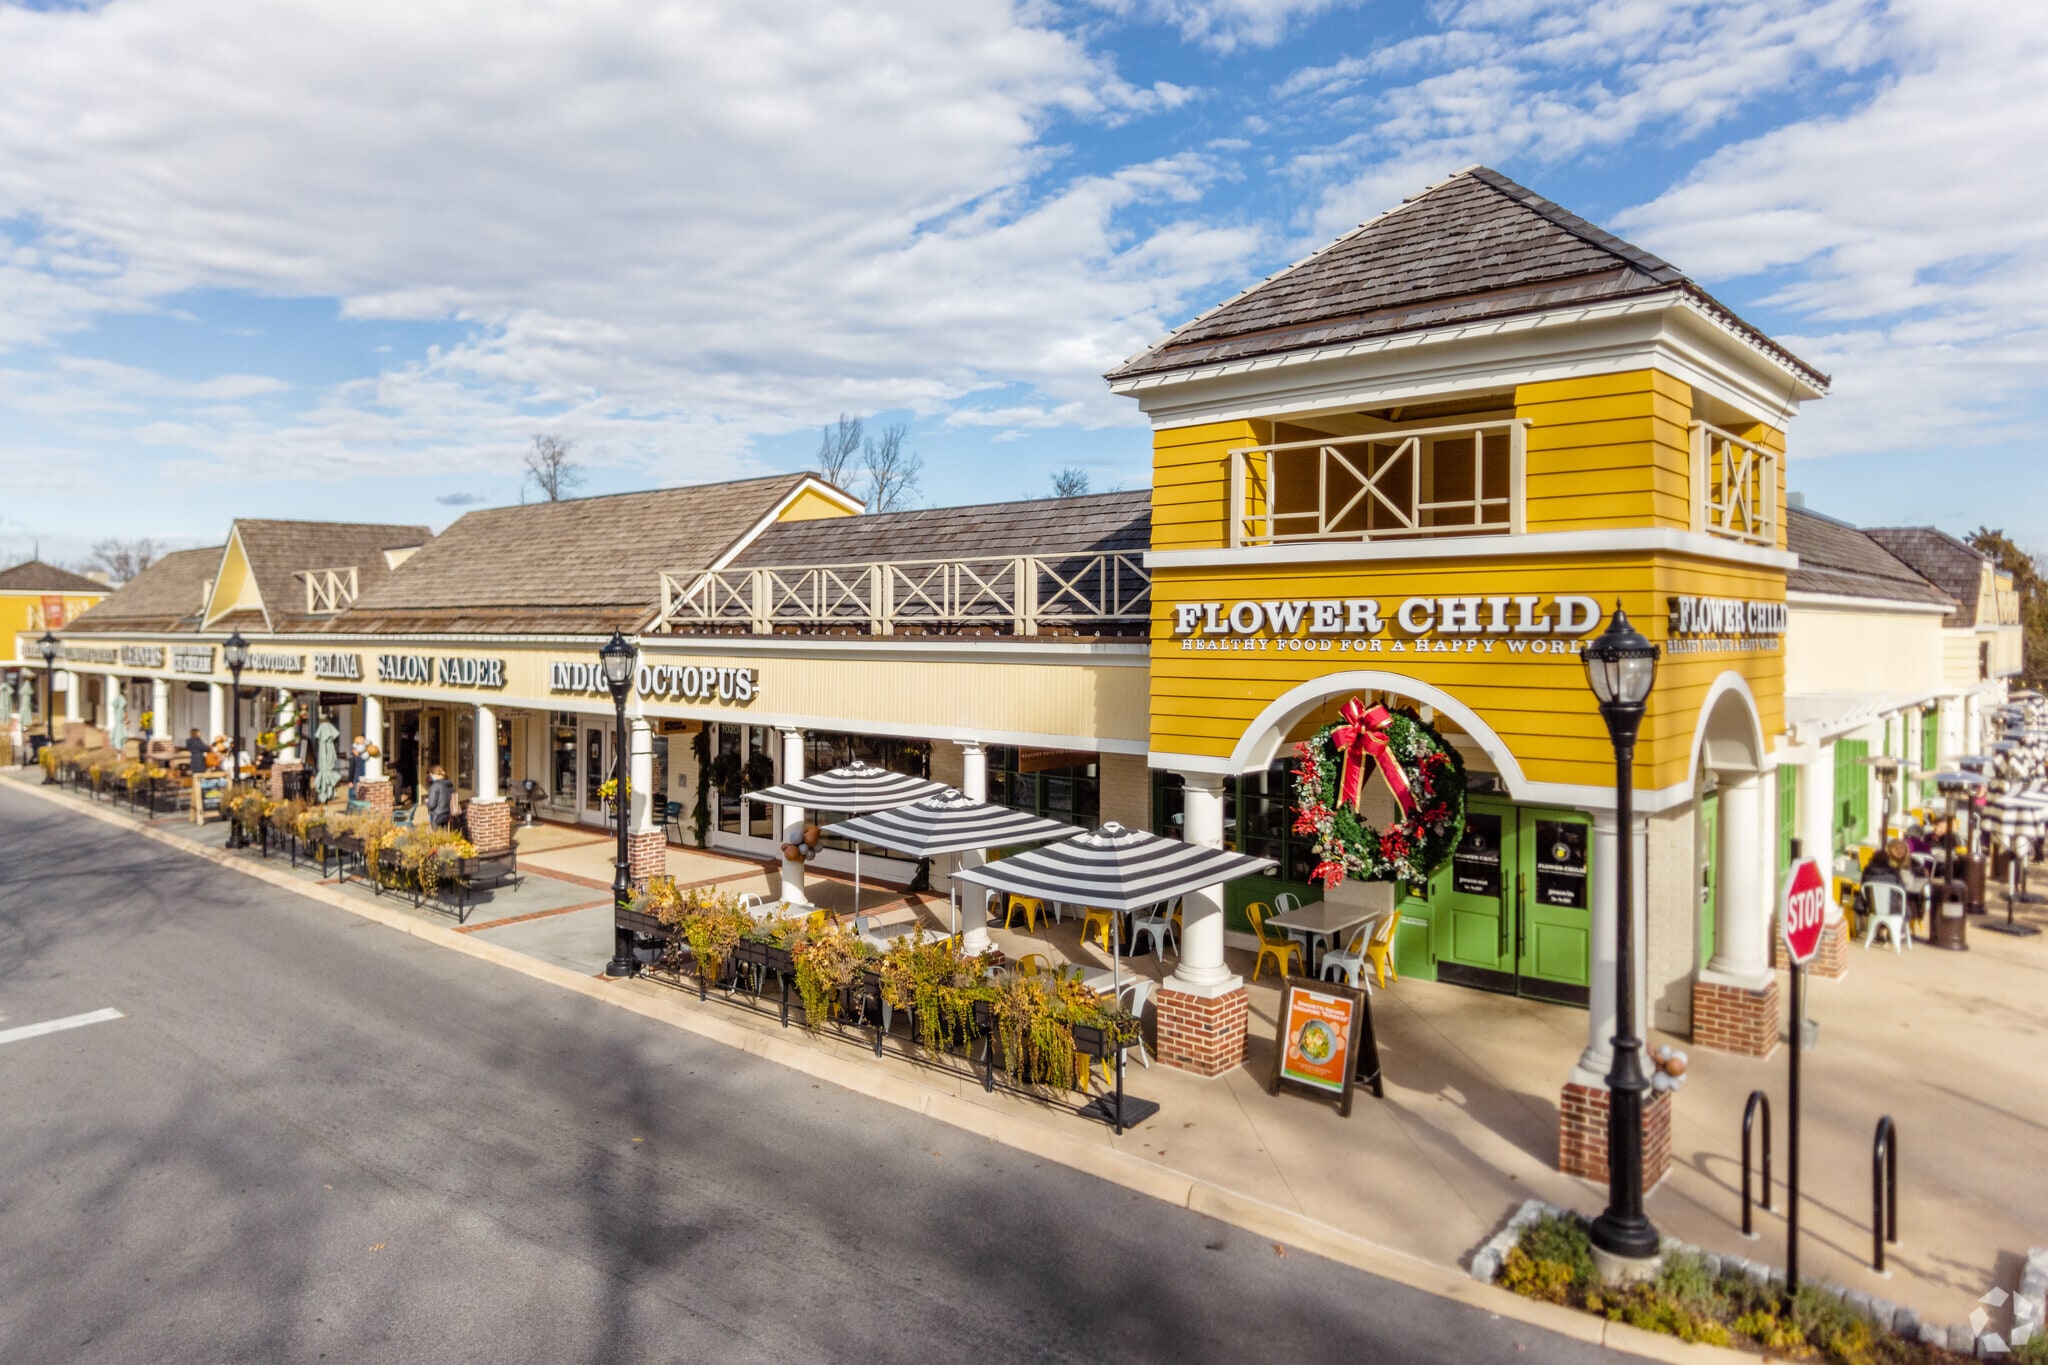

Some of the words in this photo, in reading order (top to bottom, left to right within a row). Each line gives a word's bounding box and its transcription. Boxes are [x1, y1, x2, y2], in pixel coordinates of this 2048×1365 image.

[1175, 599, 1384, 634] FLOWER
[1398, 595, 1601, 634] CHILD
[1679, 596, 1745, 633] FLOWER
[1747, 602, 1789, 633] CHILD
[1181, 639, 1269, 651] HEALTHY
[1277, 639, 1332, 651] FOOD
[1341, 639, 1383, 652] FOR
[1390, 639, 1406, 652] A
[1414, 639, 1496, 653] HAPPY
[314, 653, 359, 678] BELINA
[378, 654, 429, 684] SALON
[438, 656, 503, 687] NADER
[550, 662, 610, 692] INDIG
[636, 664, 751, 700] OCTOPUS
[1788, 886, 1824, 935] STOP
